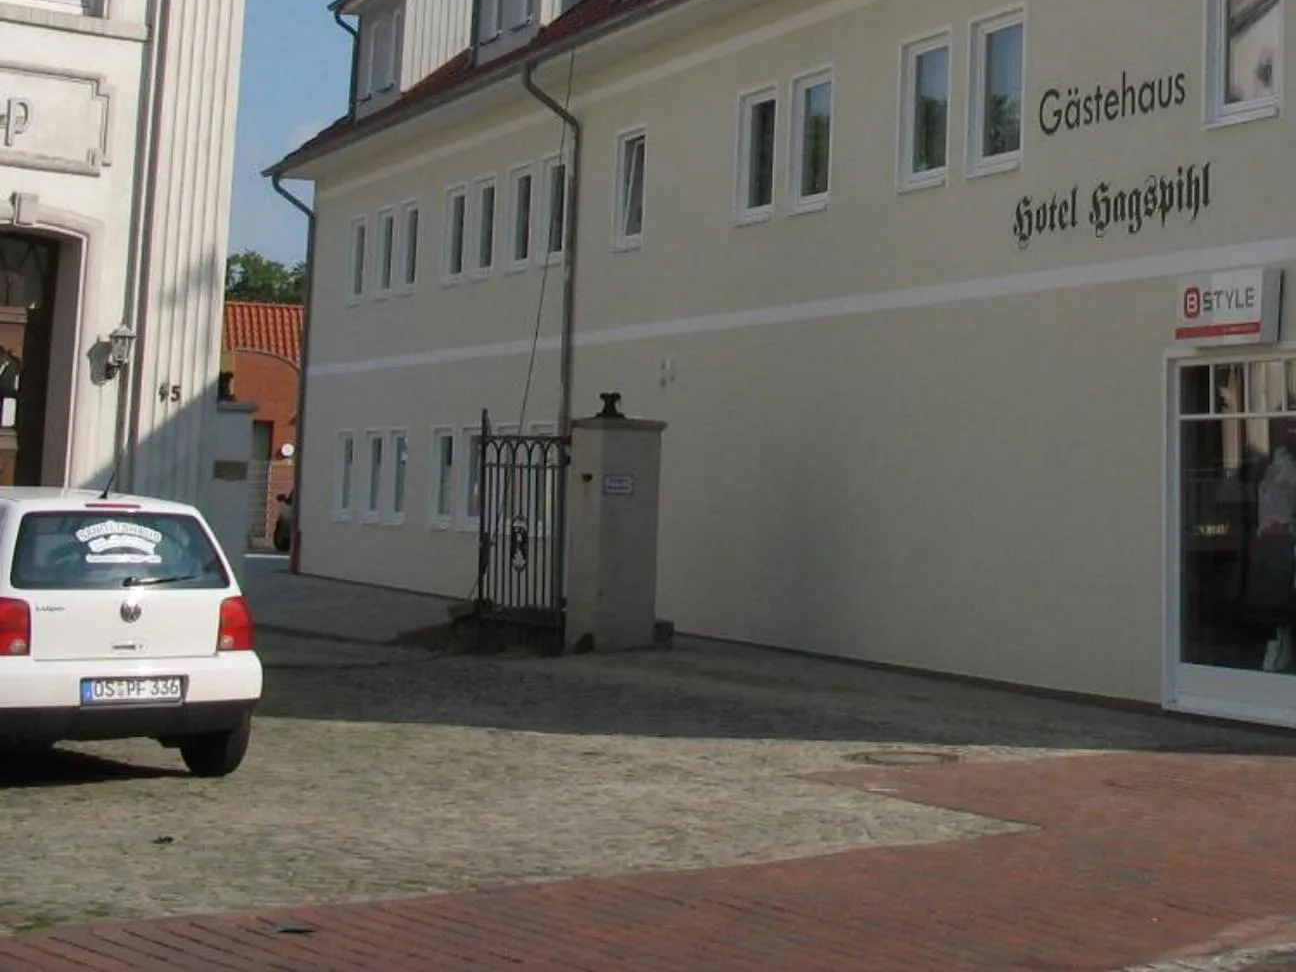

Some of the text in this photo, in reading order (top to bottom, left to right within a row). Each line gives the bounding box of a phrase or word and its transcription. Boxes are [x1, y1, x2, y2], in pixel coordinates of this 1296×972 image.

[1038, 71, 1187, 136] Gästehaus
[1013, 185, 1079, 249] Hotel
[1203, 287, 1255, 312] STYLE
